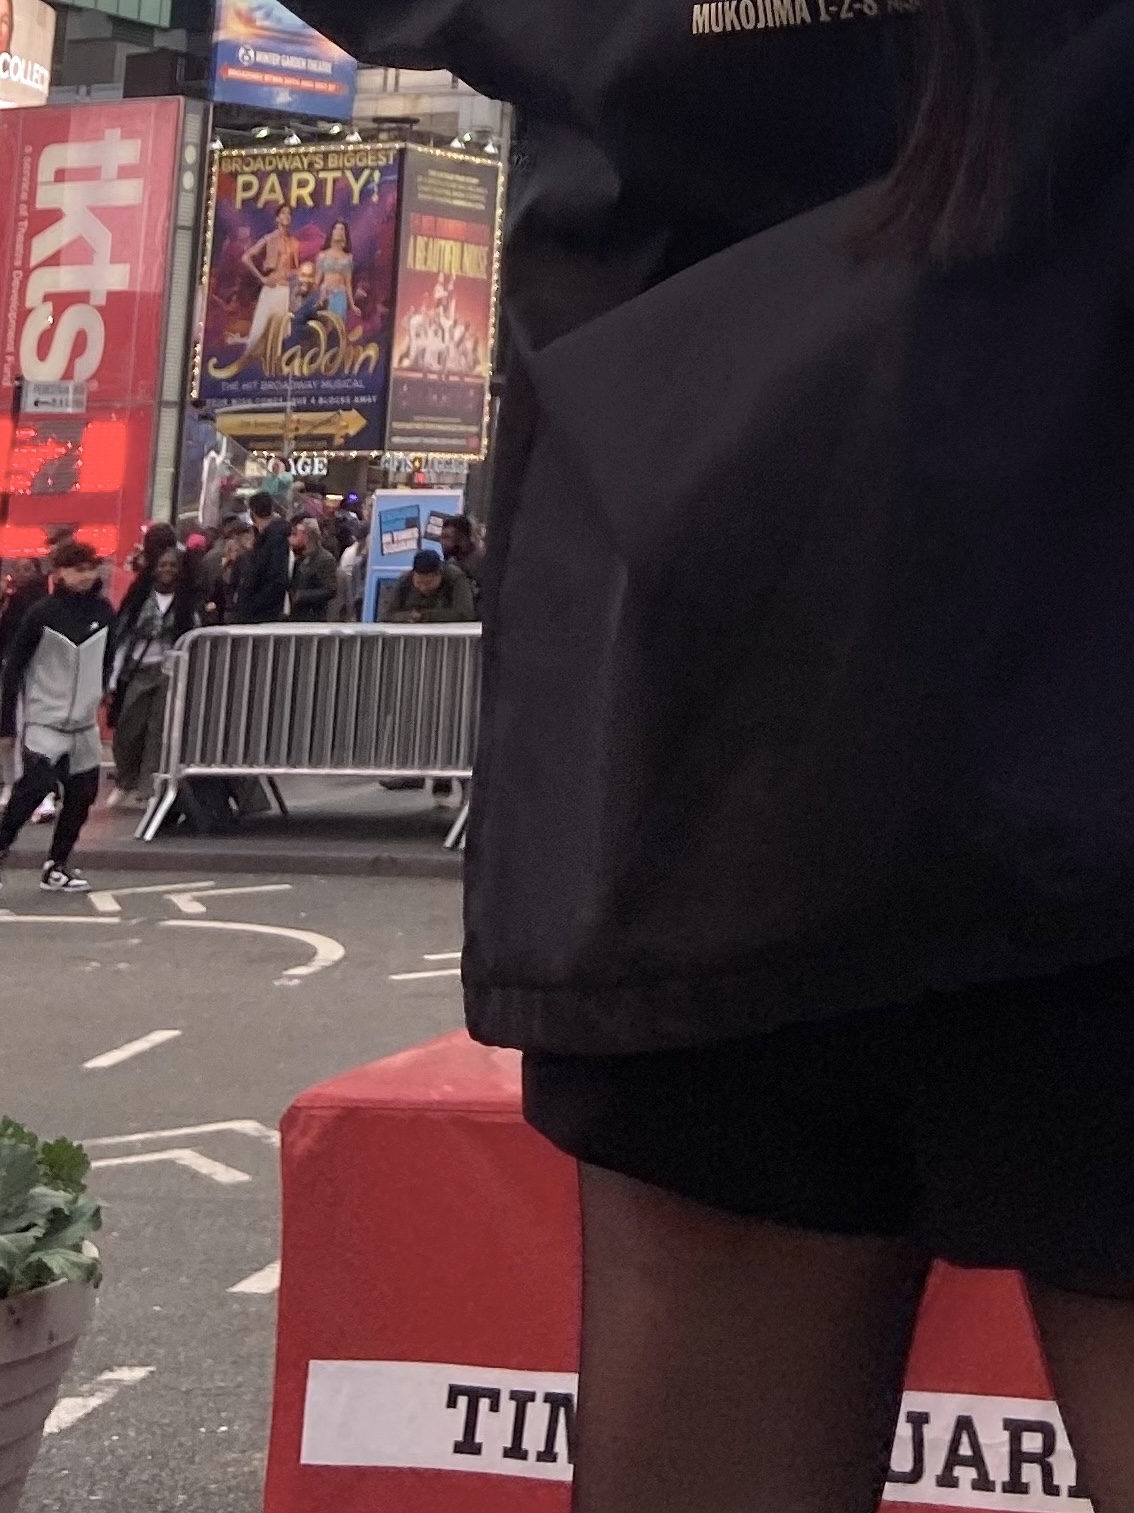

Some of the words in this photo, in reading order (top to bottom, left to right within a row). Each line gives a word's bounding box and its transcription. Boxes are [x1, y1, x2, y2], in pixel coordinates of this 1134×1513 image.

[221, 154, 324, 172] BROADWAY'S
[328, 150, 396, 168] BIGGEST
[235, 169, 381, 210] PARTY!
[19, 127, 145, 381] tkts
[208, 310, 380, 379] Aladdin
